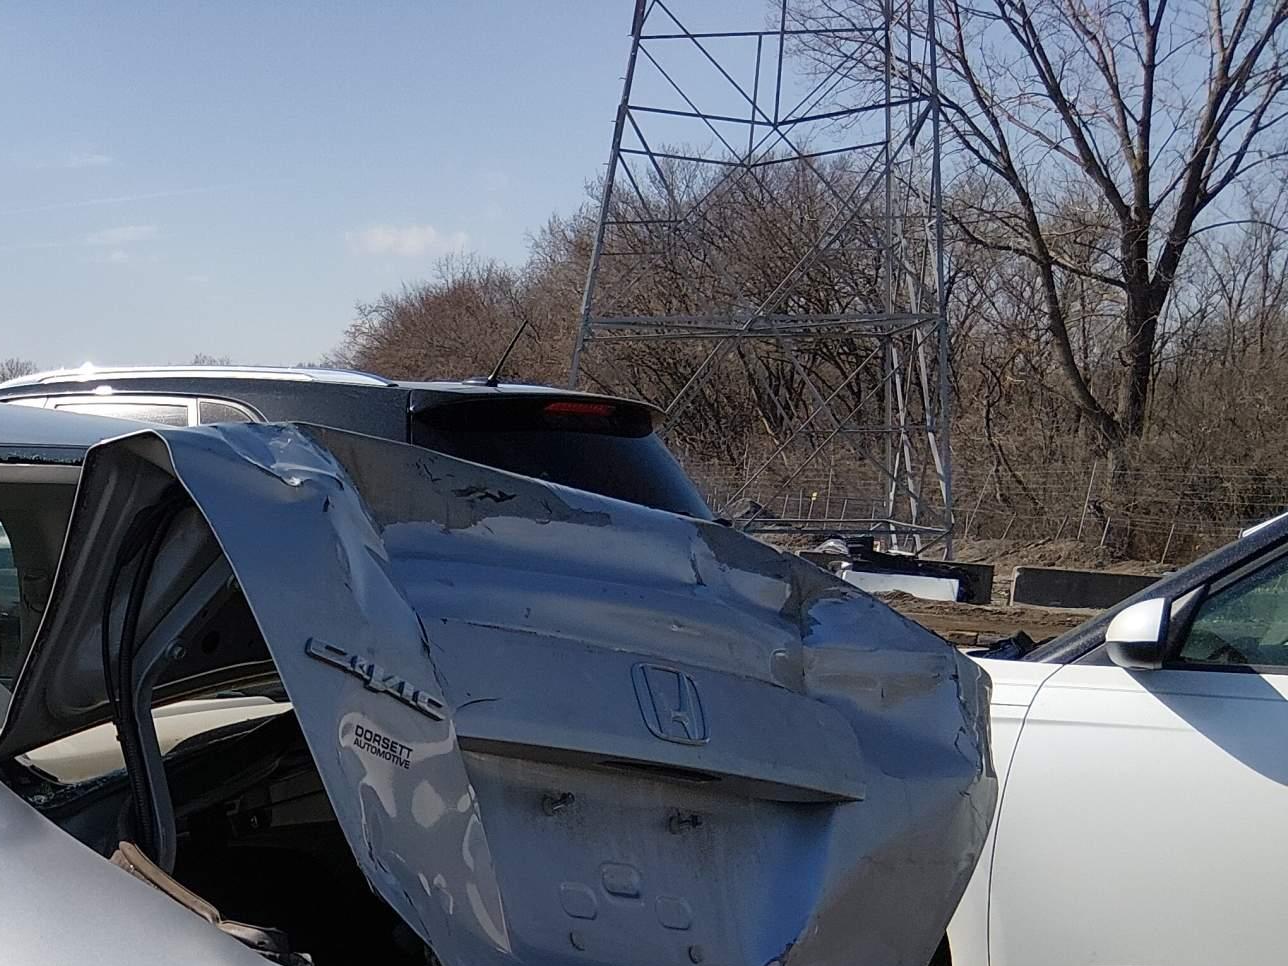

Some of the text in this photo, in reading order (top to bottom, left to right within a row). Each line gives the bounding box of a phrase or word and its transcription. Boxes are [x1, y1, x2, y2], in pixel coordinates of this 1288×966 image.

[304, 637, 446, 722] CIVIC
[353, 739, 411, 770] AUTOMOTIVE
[354, 725, 413, 758] DORSETT
